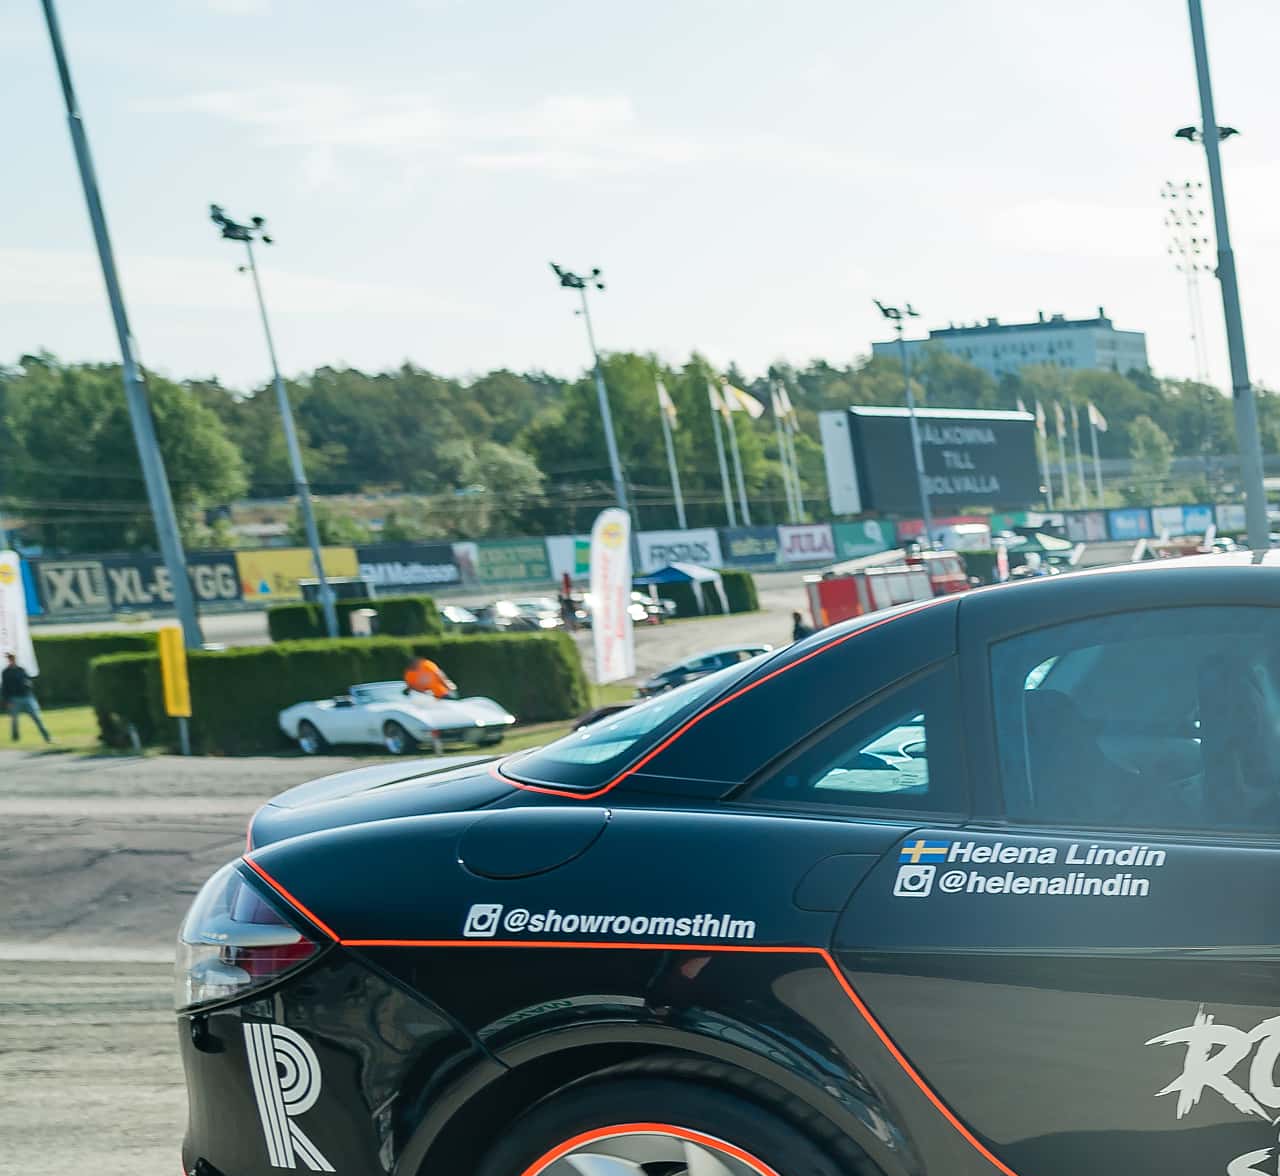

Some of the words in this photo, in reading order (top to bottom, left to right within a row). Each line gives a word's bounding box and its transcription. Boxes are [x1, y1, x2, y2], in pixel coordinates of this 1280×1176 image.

[943, 450, 976, 470] TILL
[782, 532, 835, 554] JULA
[947, 842, 1057, 864] Helena
[1065, 844, 1167, 867] Lindin
[938, 870, 1150, 896] @helenalindin
[503, 908, 756, 938] @showroomsthlm
